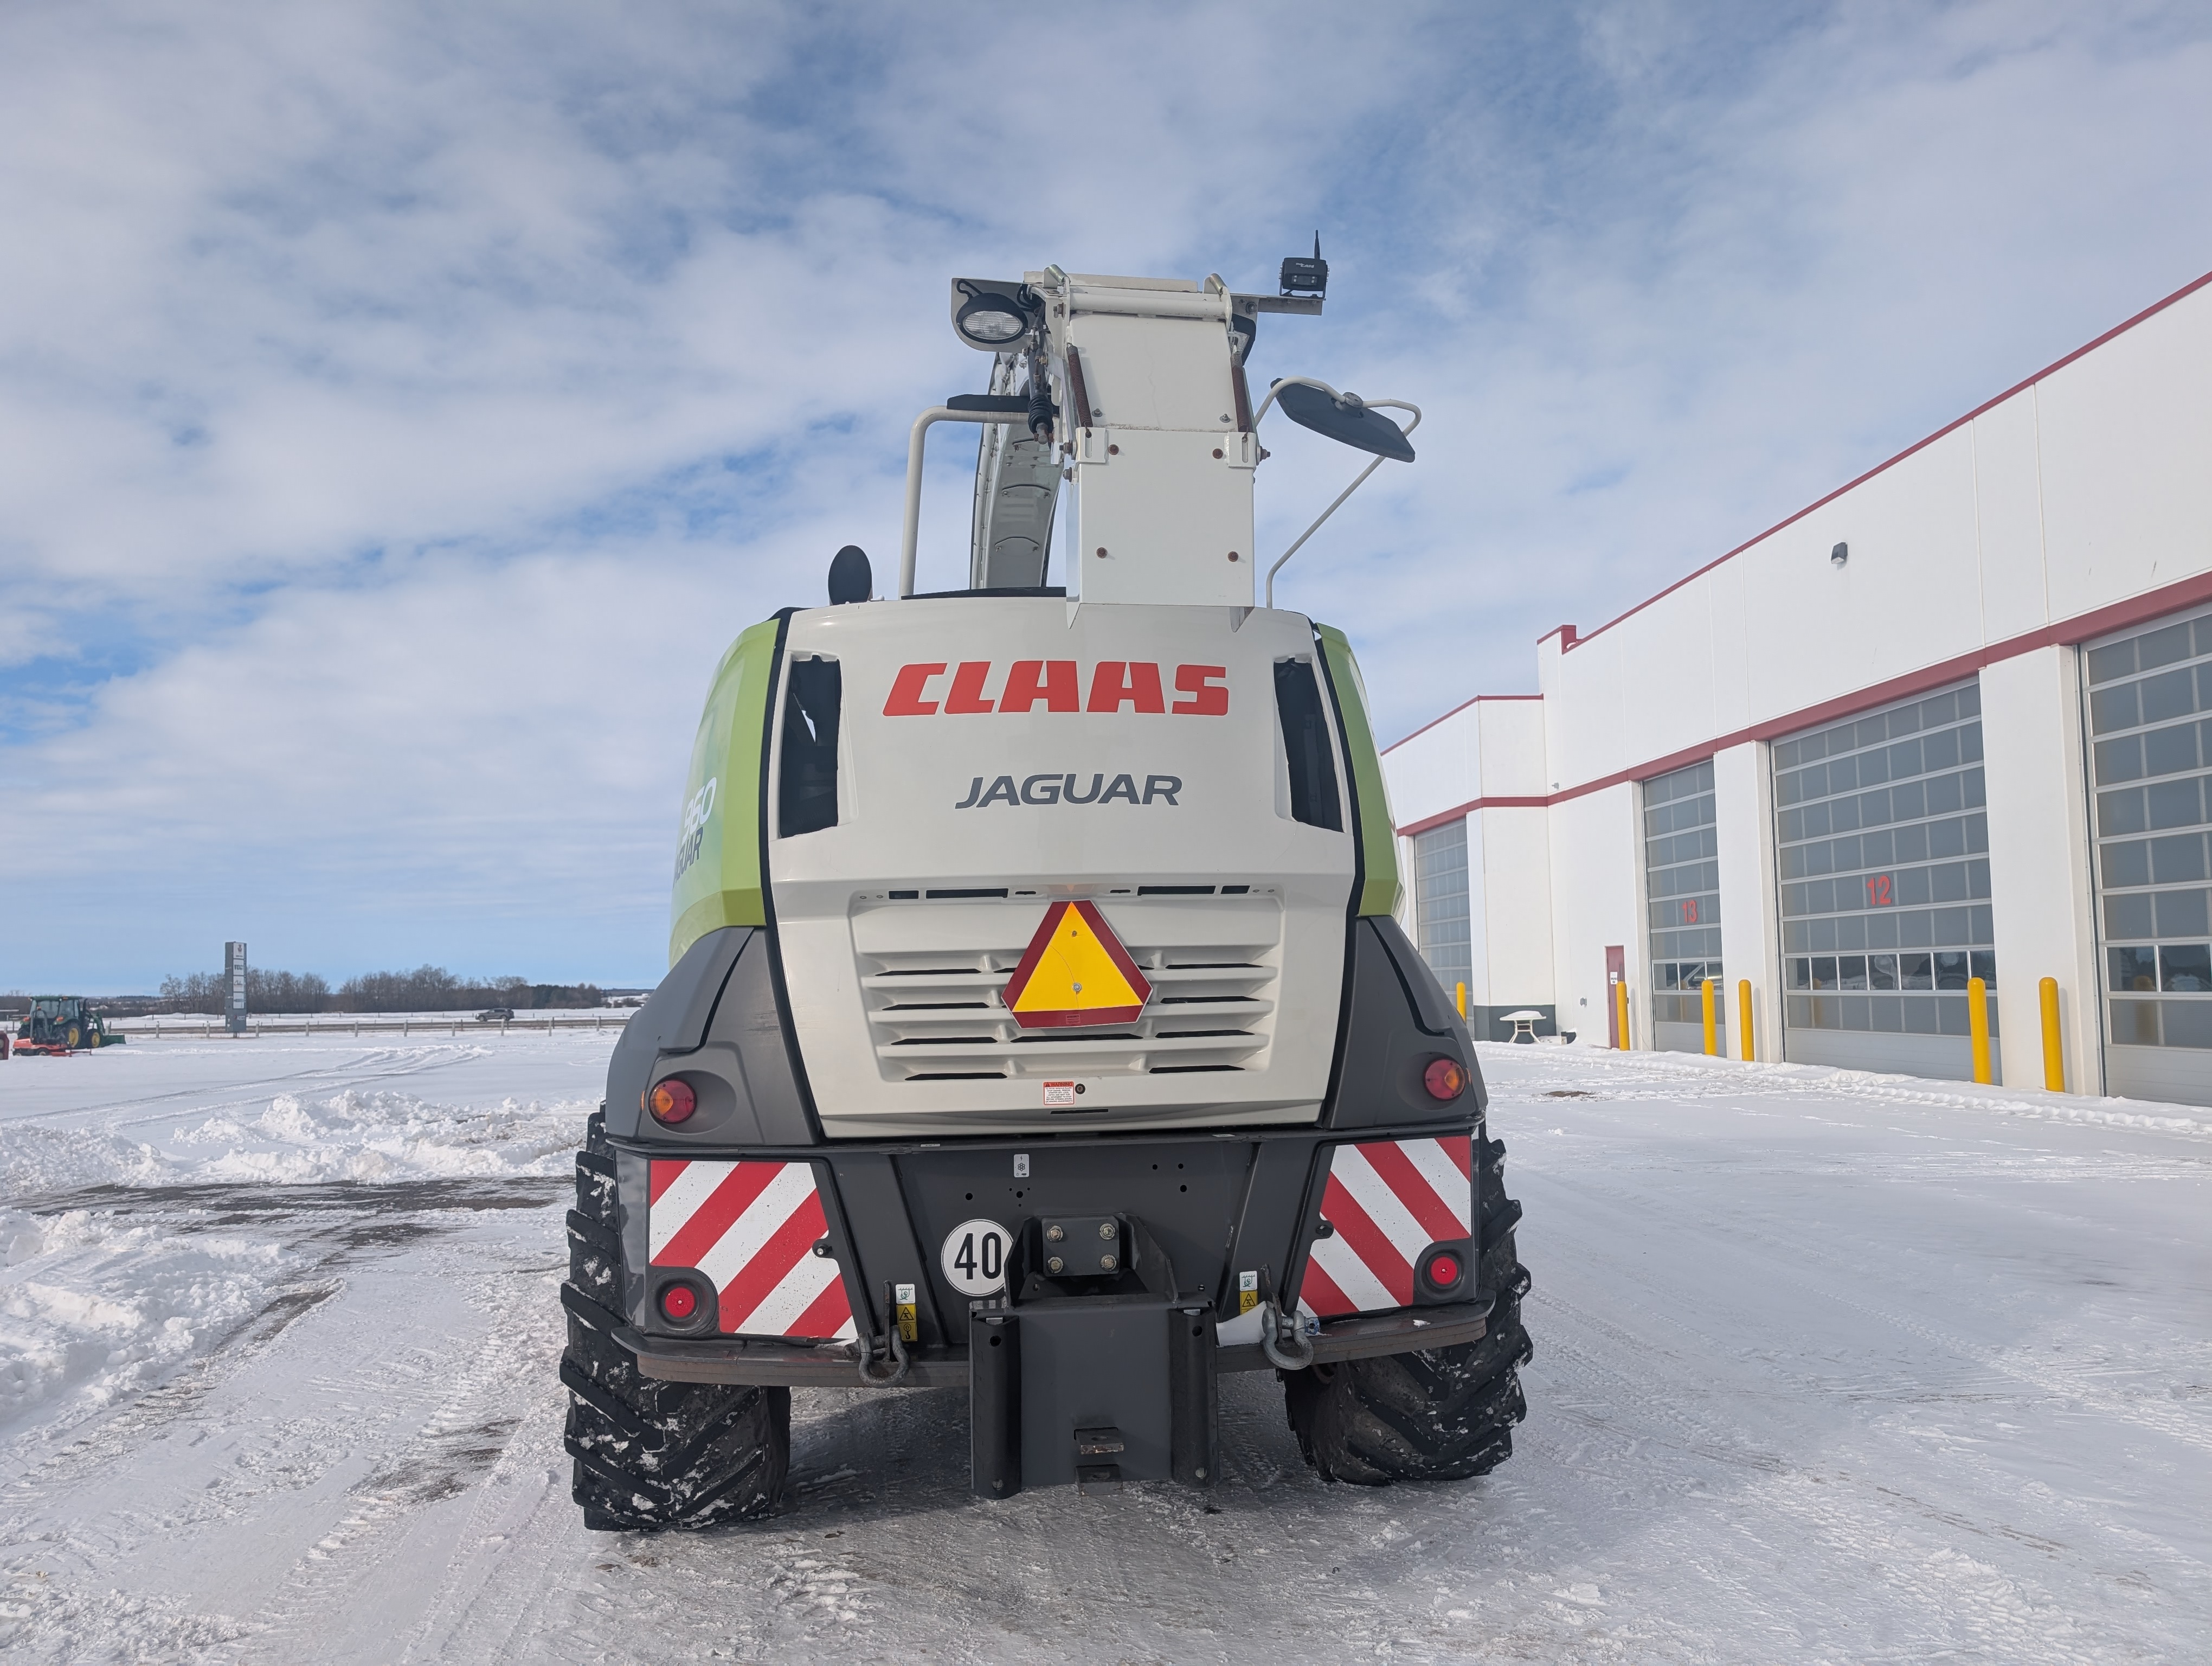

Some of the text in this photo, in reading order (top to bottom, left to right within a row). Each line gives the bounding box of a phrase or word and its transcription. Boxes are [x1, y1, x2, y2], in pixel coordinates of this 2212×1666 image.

[882, 660, 1229, 716] CLAAS
[681, 777, 717, 844] 960
[955, 773, 1182, 809] JAGUAR
[1682, 899, 1697, 923] 13
[1867, 875, 1892, 905] 12
[954, 1232, 1001, 1280] 40
